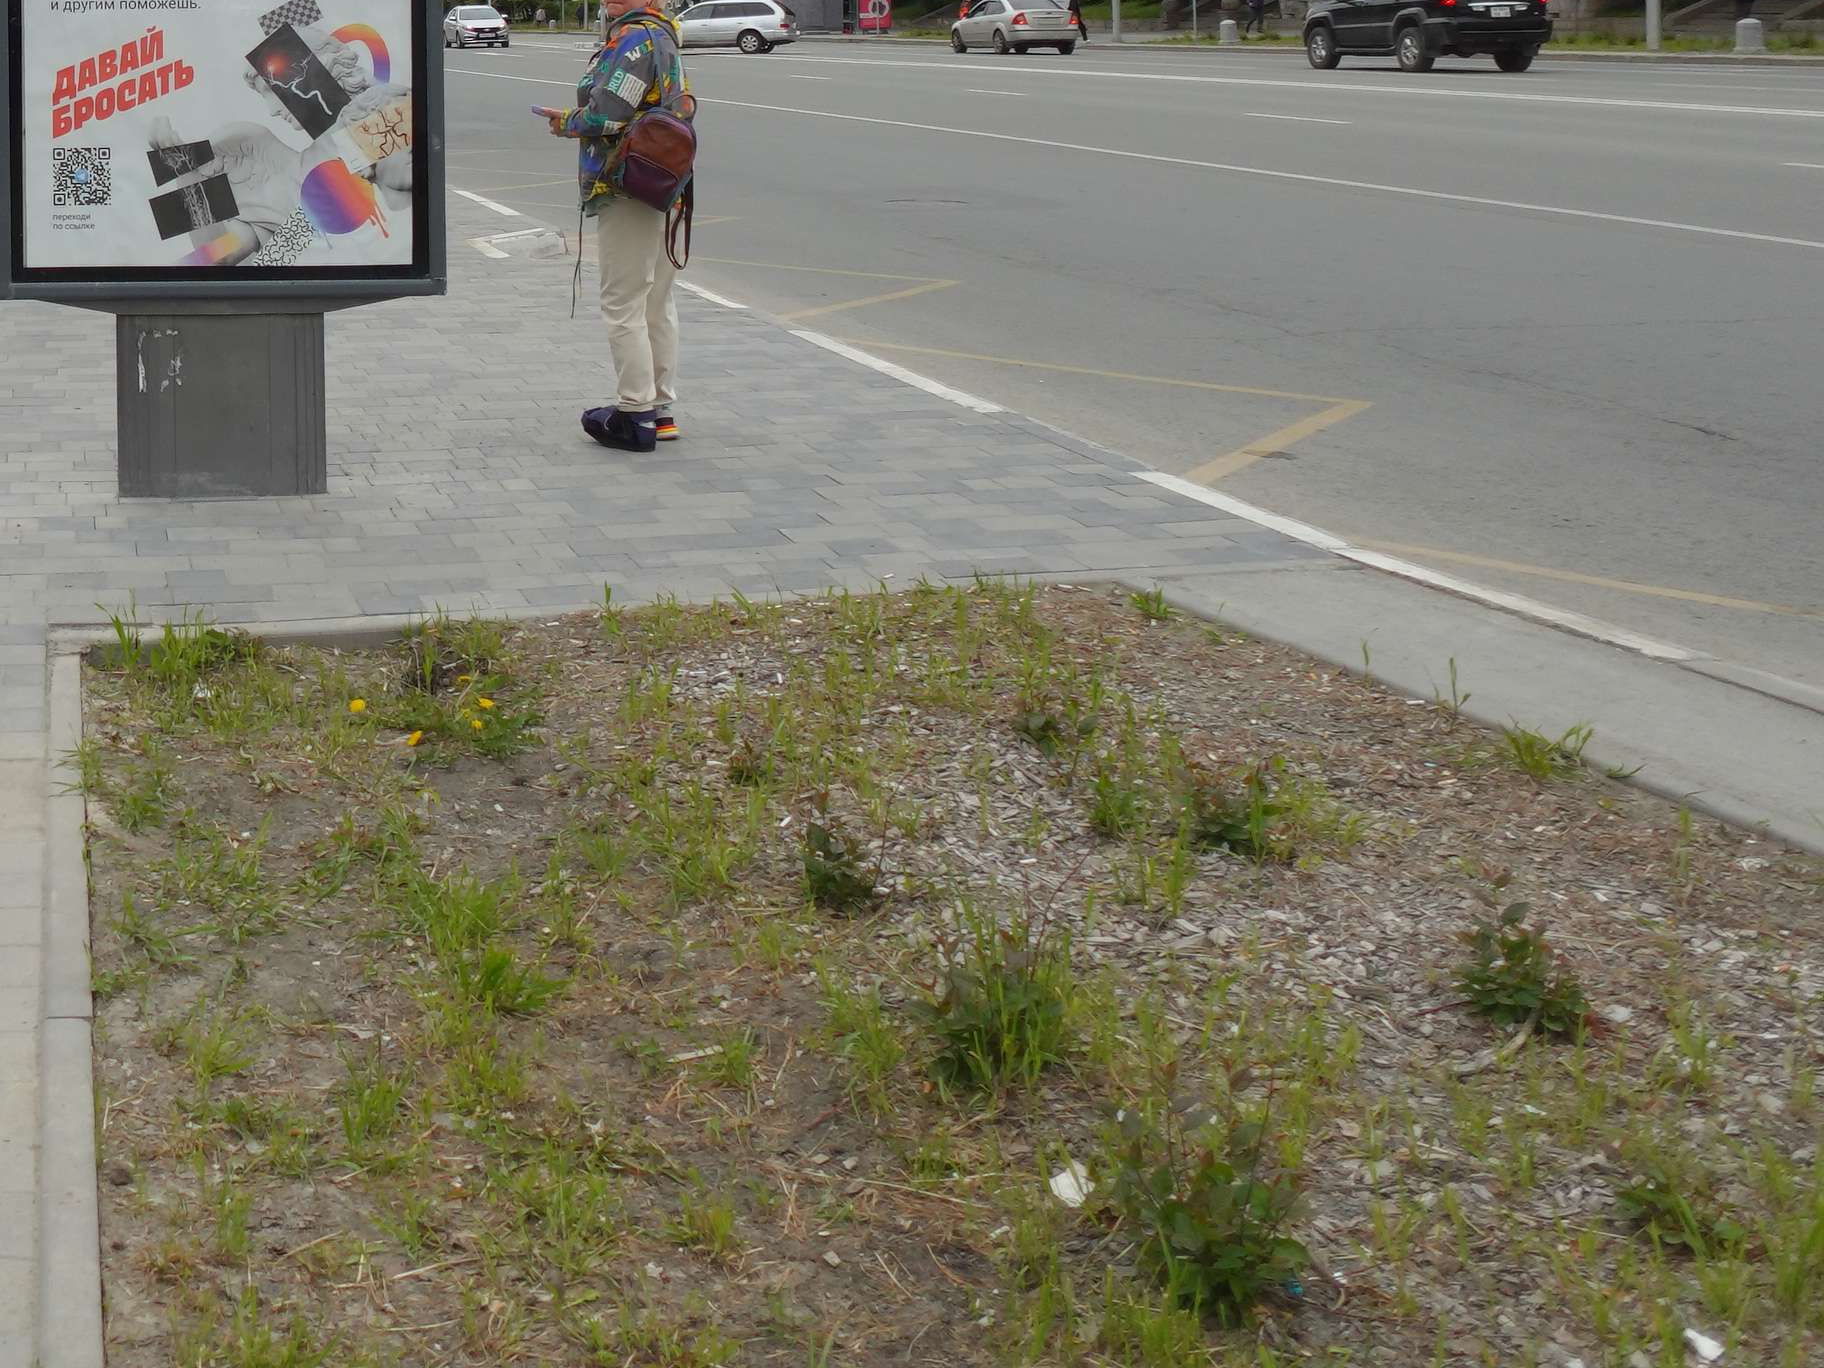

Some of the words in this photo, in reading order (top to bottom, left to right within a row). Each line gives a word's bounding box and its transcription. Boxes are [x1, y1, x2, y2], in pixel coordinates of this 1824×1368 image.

[51, 1, 59, 10] и
[63, 1, 115, 13] другим
[119, 0, 201, 10] поможешь.
[52, 25, 164, 106] ДАВАЙ
[52, 59, 194, 139] БРОСАТЬ
